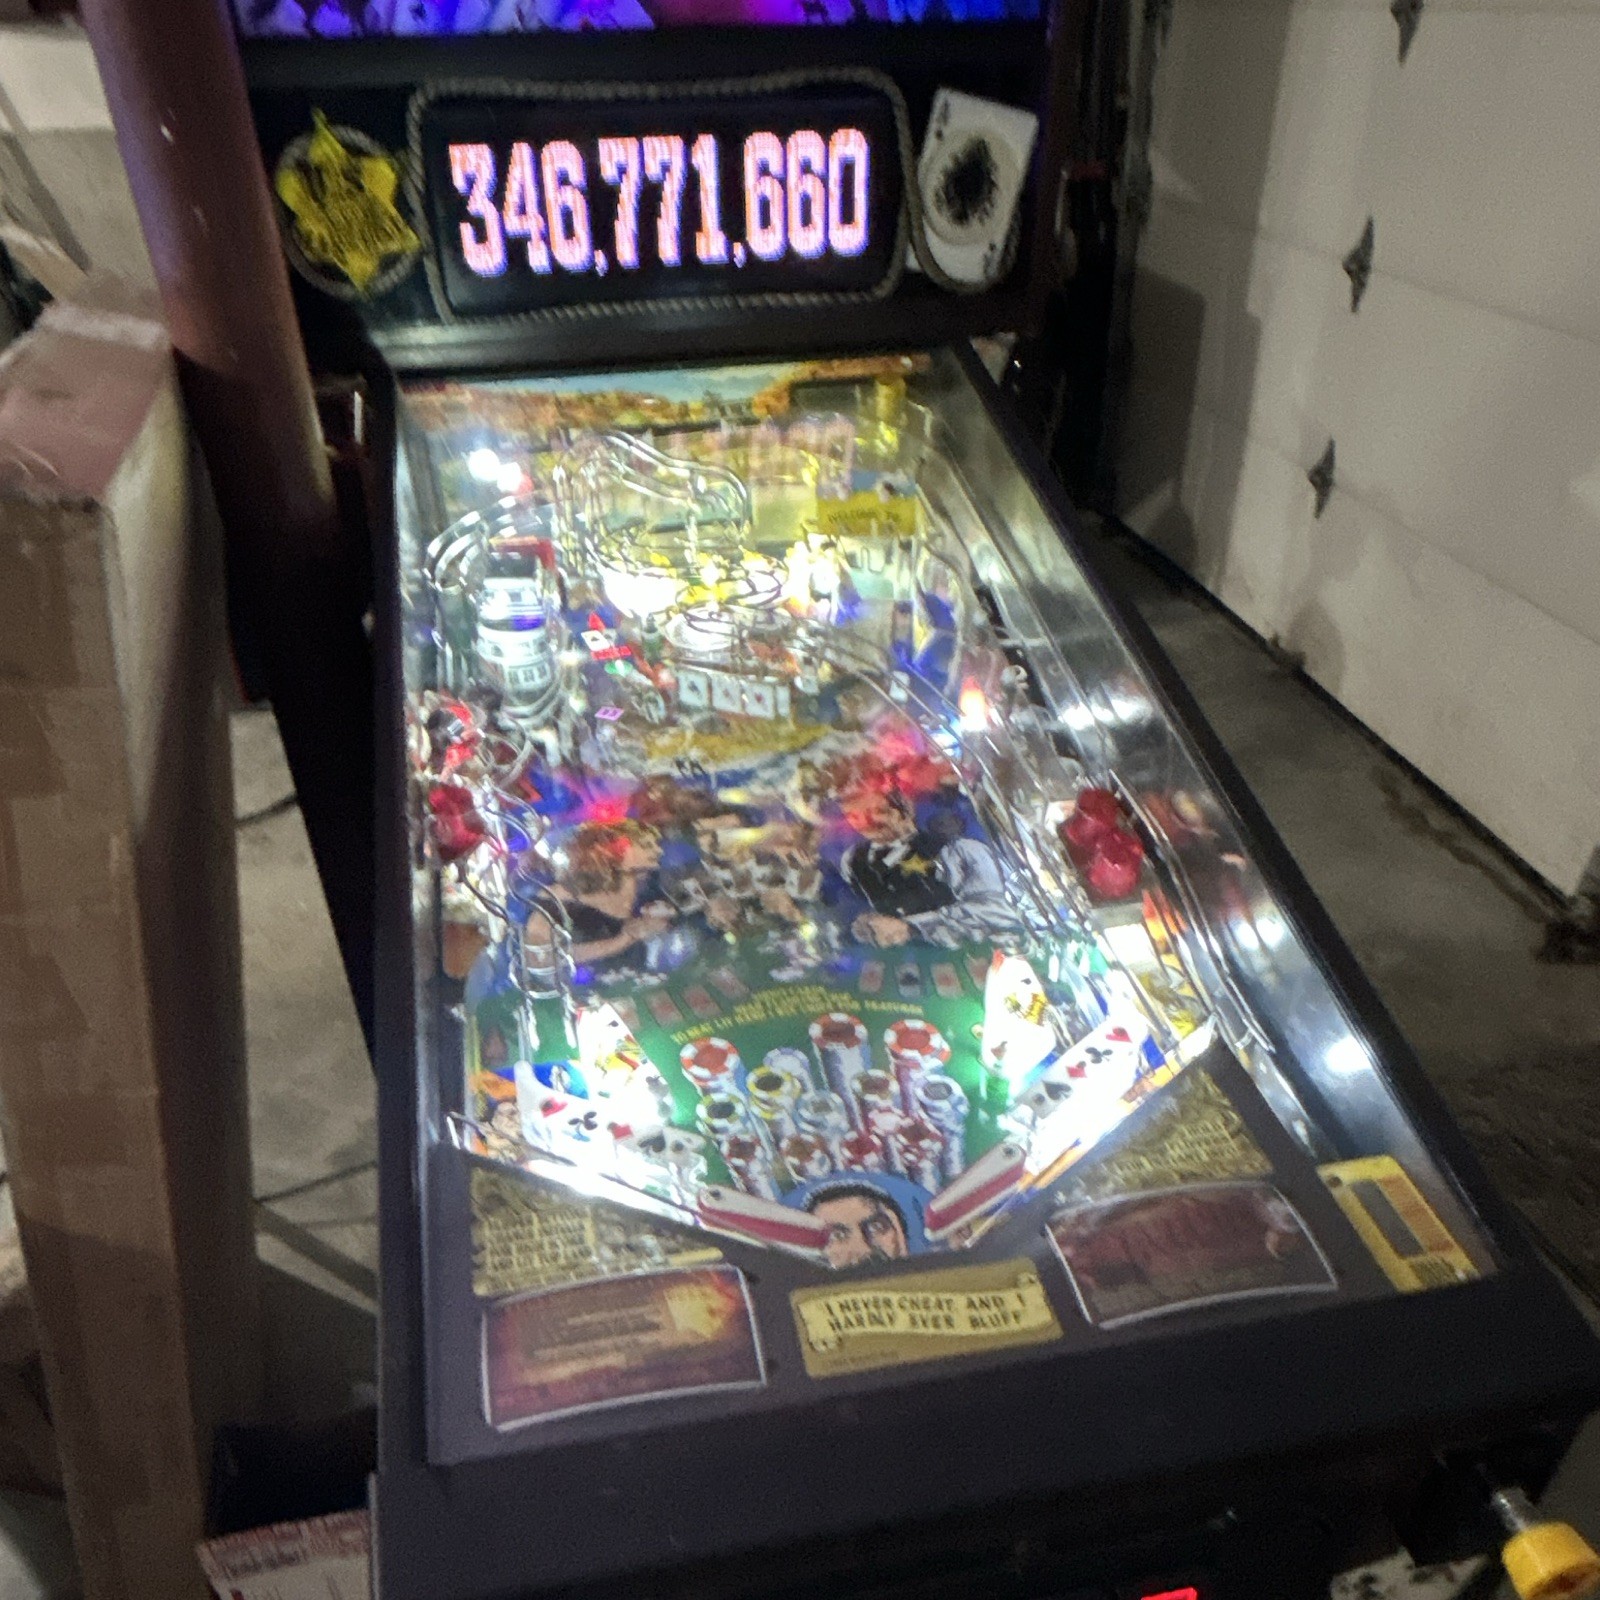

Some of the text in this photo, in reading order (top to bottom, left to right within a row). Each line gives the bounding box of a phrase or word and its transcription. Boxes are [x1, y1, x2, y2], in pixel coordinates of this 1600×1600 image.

[448, 128, 870, 278] 346,771,660
[823, 1301, 835, 1317] I
[837, 1296, 893, 1313] NEVER
[966, 1296, 1006, 1312] AND
[909, 1313, 956, 1330] EVER
[968, 1310, 1021, 1331] BLUFF
